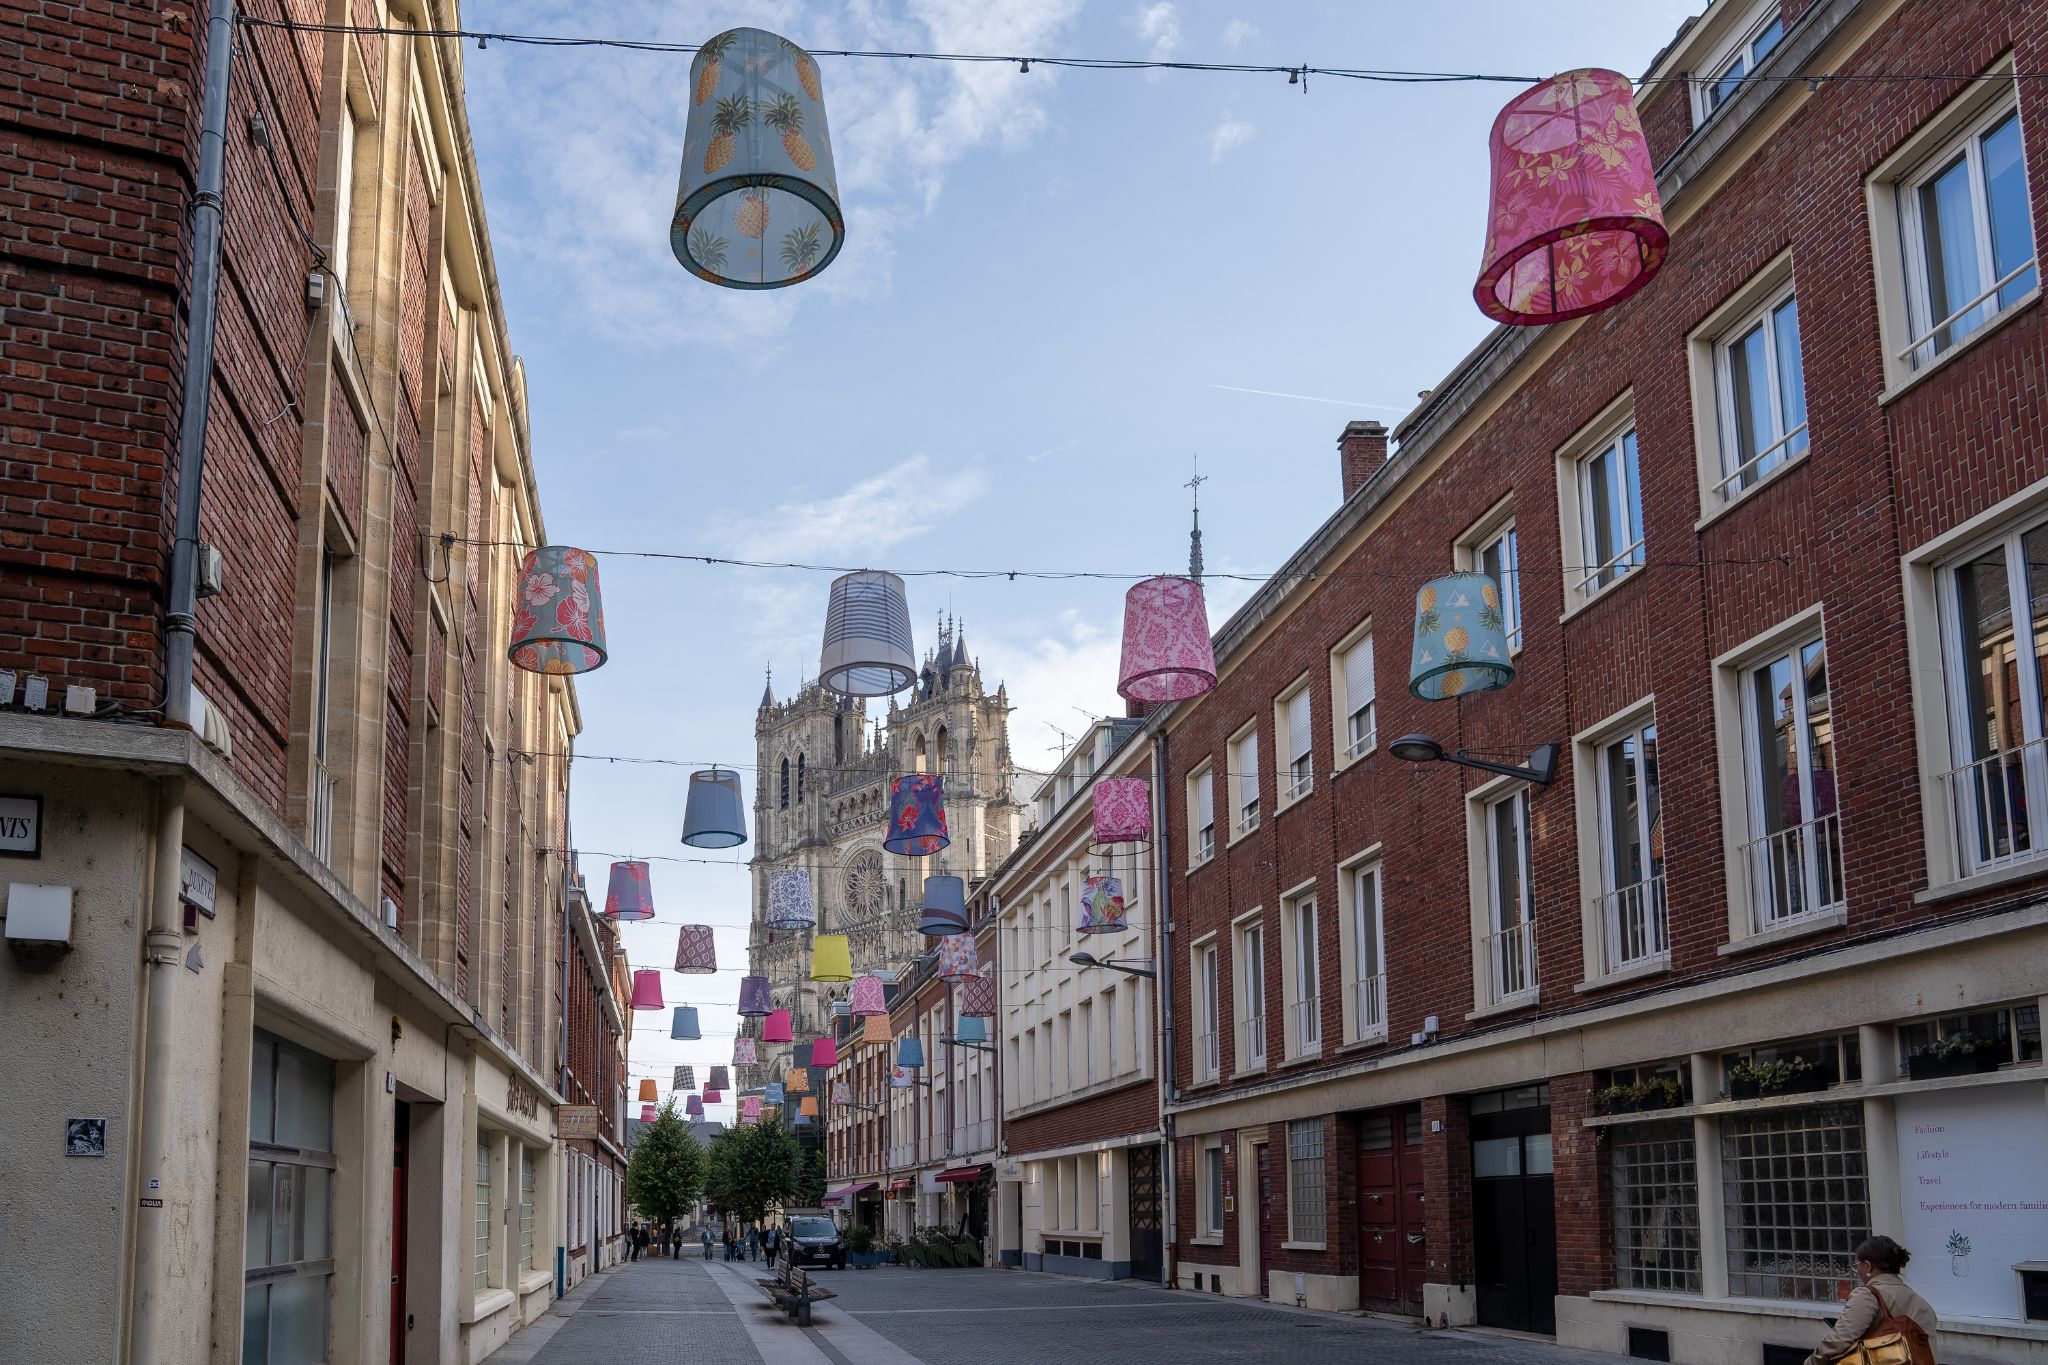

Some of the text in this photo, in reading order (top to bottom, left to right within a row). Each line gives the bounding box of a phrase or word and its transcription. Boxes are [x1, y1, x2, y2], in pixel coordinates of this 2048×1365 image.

[1915, 1125, 1945, 1134] Fashion
[1917, 1150, 1949, 1161] Lifestyle
[1918, 1176, 1941, 1185] Travel
[1920, 1201, 1967, 1213] Experiences
[1969, 1201, 1981, 1210] for
[1984, 1201, 2017, 1210] modern
